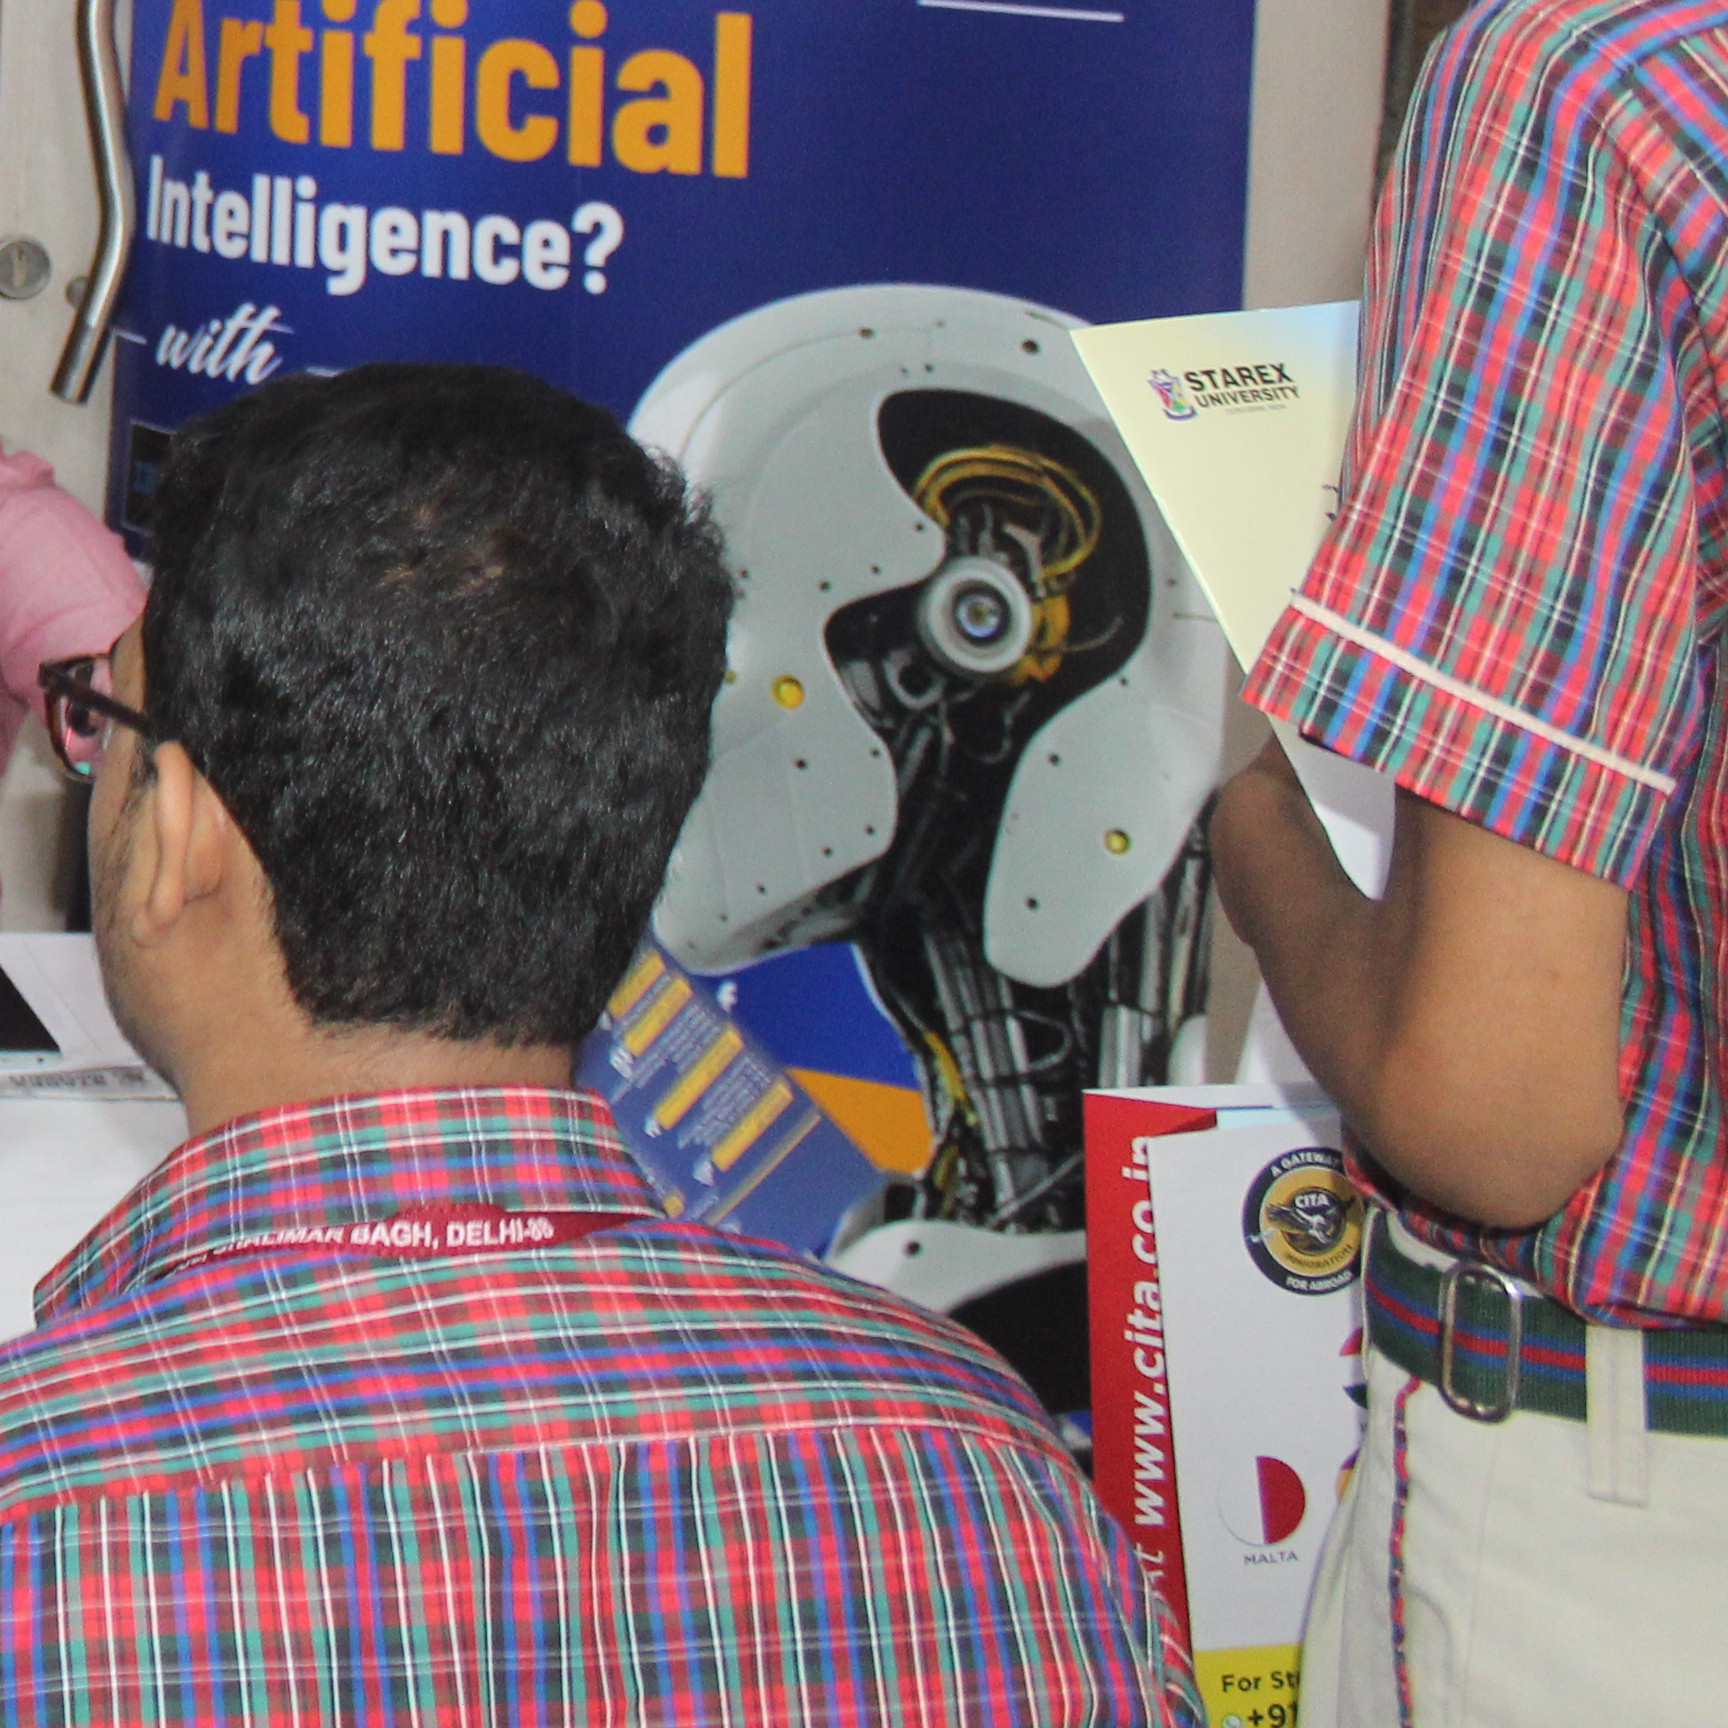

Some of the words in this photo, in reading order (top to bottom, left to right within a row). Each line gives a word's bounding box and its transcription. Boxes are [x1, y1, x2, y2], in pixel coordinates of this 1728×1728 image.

[145, 153, 625, 296] Intelligence?
[155, 300, 293, 386] with
[1182, 362, 1296, 393] STAREX
[1194, 384, 1300, 409] UNIVERSITY
[1294, 1193, 1331, 1208] CITA
[1243, 1551, 1299, 1566] MALTA
[1221, 1674, 1262, 1693] For
